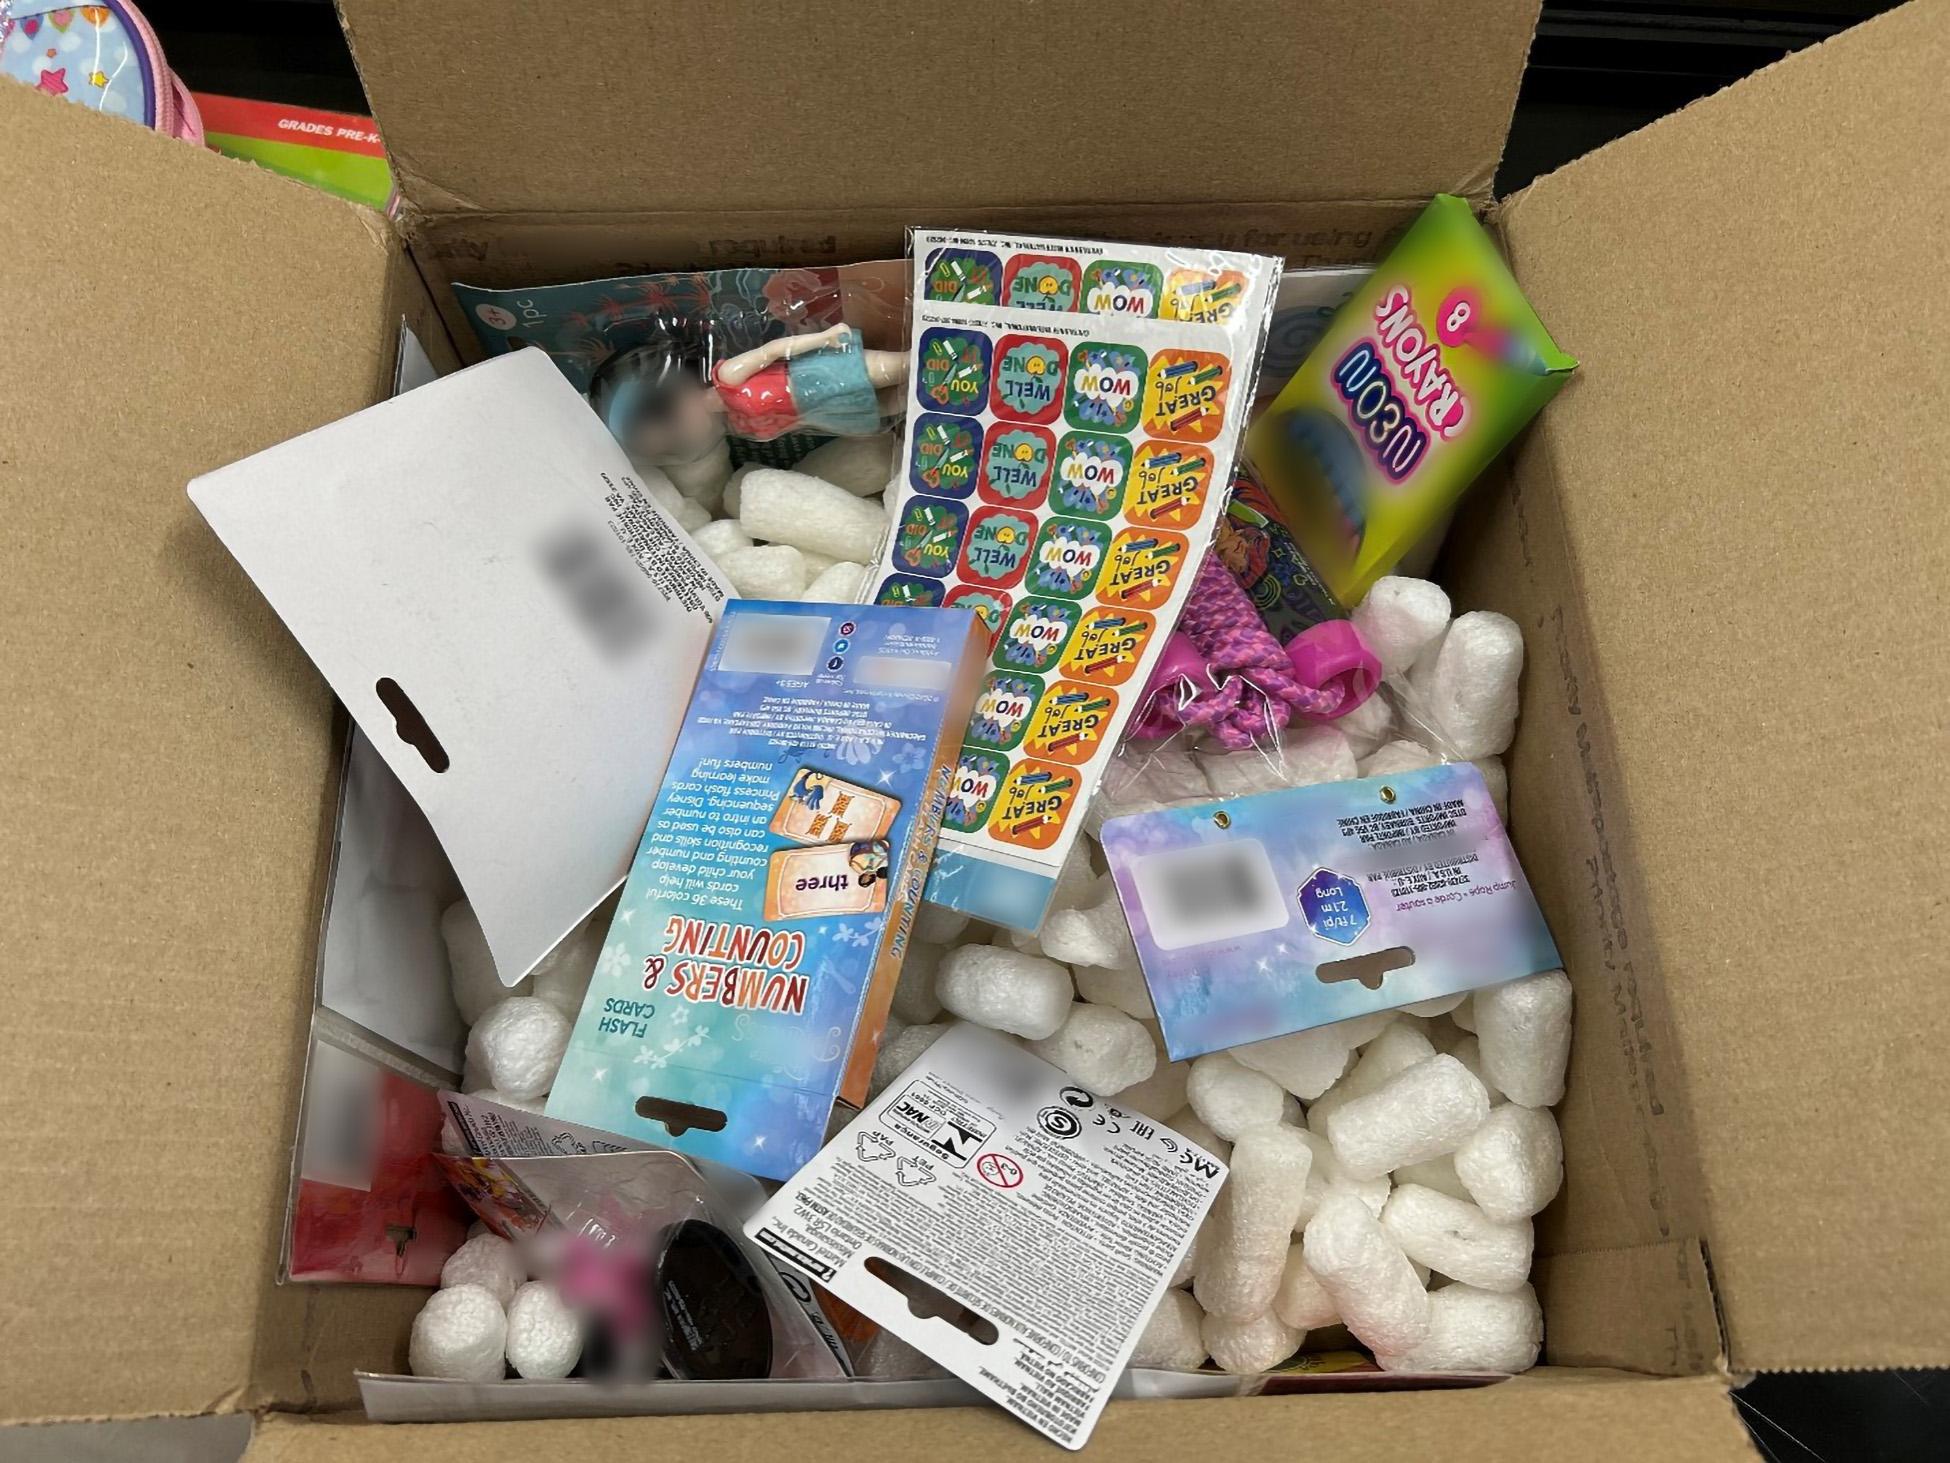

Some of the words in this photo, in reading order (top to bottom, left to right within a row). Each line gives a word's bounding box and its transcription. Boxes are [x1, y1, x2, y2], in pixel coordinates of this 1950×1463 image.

[278, 119, 333, 136] GRADES
[1094, 293, 1145, 315] WOW
[1446, 302, 1471, 332] 8
[1375, 286, 1472, 437] CRAYONS
[951, 379, 979, 394] YOU
[1005, 379, 1051, 402] WELL
[1081, 375, 1131, 397] WOW
[1155, 385, 1217, 417] GREAT
[1337, 349, 1422, 473] NEON
[942, 463, 968, 478] YOU
[993, 466, 1037, 488] WELL
[1068, 463, 1115, 484] WOW
[1136, 476, 1199, 505] GREAT
[923, 544, 949, 558] YOU
[974, 547, 1016, 569] WELL
[1044, 548, 1092, 567] WOW
[1109, 559, 1171, 586] GREAT
[1014, 624, 1060, 642] WOW
[1074, 637, 1137, 661] GREAT
[981, 699, 1024, 718] WOW
[1038, 714, 1100, 739] GREAT
[698, 755, 720, 768] fun!
[724, 758, 772, 772] numbers
[691, 768, 735, 782] learning
[738, 773, 768, 785] make
[671, 780, 701, 793] cards
[703, 783, 730, 795] flash
[734, 786, 779, 799] Princess
[667, 792, 703, 806] Disney
[707, 796, 773, 812] sequencing.
[663, 807, 706, 819] number
[1002, 795, 1062, 820] GREAT
[709, 810, 719, 822] to
[723, 812, 749, 824] intro
[752, 814, 766, 825] an
[657, 819, 670, 830] as
[672, 820, 698, 832] used
[701, 823, 715, 835] be
[718, 825, 741, 838] also
[652, 832, 672, 844] and
[744, 827, 764, 839] can
[675, 835, 701, 847] skills
[704, 838, 767, 852] recognition
[646, 846, 689, 858] number
[692, 850, 714, 862] and
[651, 860, 695, 873] develop
[717, 853, 767, 867] counting
[698, 865, 724, 878] child
[727, 866, 754, 879] your
[659, 875, 683, 888] help
[685, 878, 702, 890] will
[707, 881, 738, 894] cards
[795, 874, 849, 892] three
[1491, 876, 1517, 893] Jump
[646, 888, 689, 901] colorful
[1314, 883, 1343, 900] Long
[1433, 889, 1463, 906] Corde
[1467, 882, 1493, 899] Rope
[691, 892, 706, 905] 36
[709, 896, 742, 909] These
[1321, 913, 1349, 930] ft/pi
[1348, 913, 1357, 925] 7
[661, 913, 806, 971] COUNTING
[640, 954, 665, 991] &
[664, 956, 808, 1017] NUMBERS
[601, 996, 655, 1019] CARDS
[597, 1015, 647, 1038] FLASH
[871, 1128, 894, 1146] PAP
[910, 1153, 934, 1171] PET
[785, 1227, 818, 1252] Canada
[829, 1226, 862, 1250] Ontario
[815, 1245, 846, 1268] Mattel
